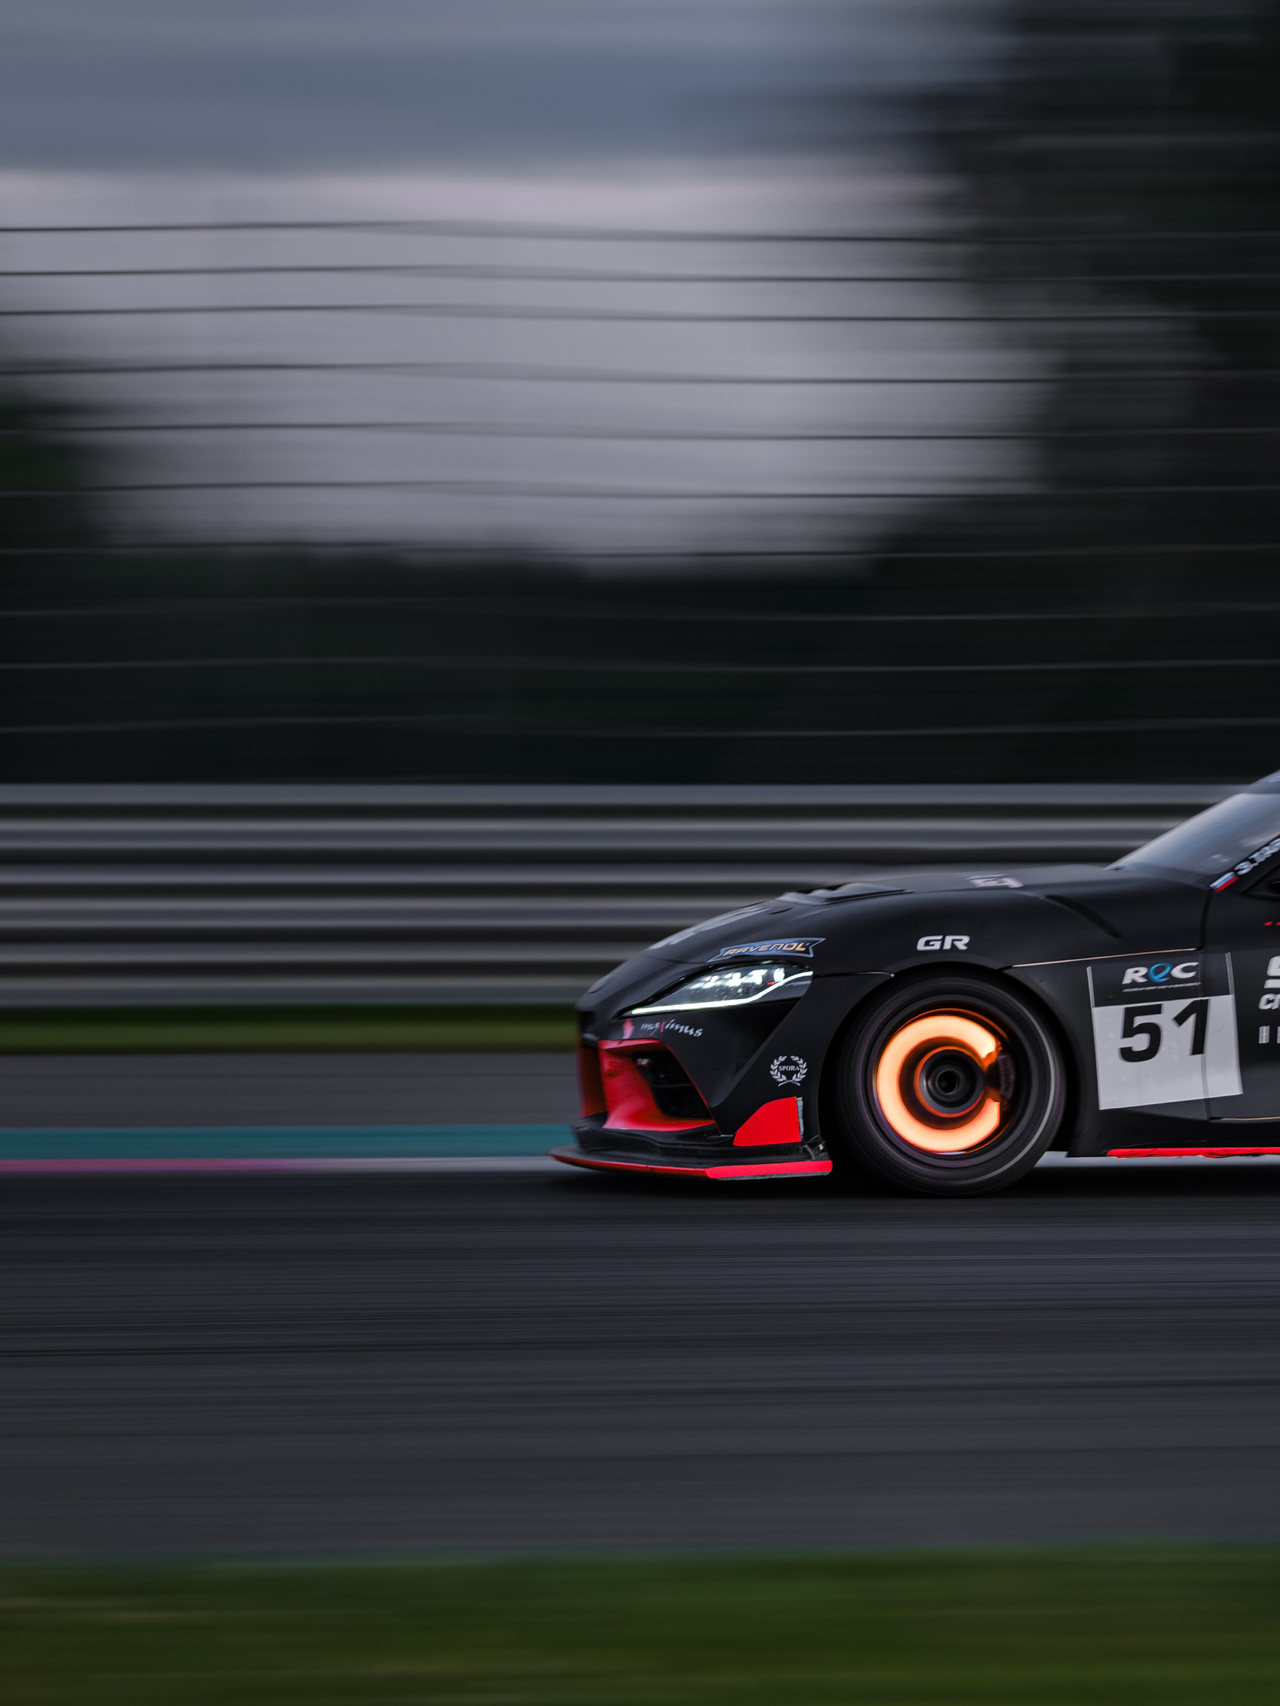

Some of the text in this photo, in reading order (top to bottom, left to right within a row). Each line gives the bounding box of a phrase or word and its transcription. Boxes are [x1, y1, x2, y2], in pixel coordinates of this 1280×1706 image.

[722, 942, 807, 957] RAVENOL
[916, 934, 971, 951] GR
[1117, 998, 1211, 1064] 51
[778, 1064, 801, 1073] SPORA
